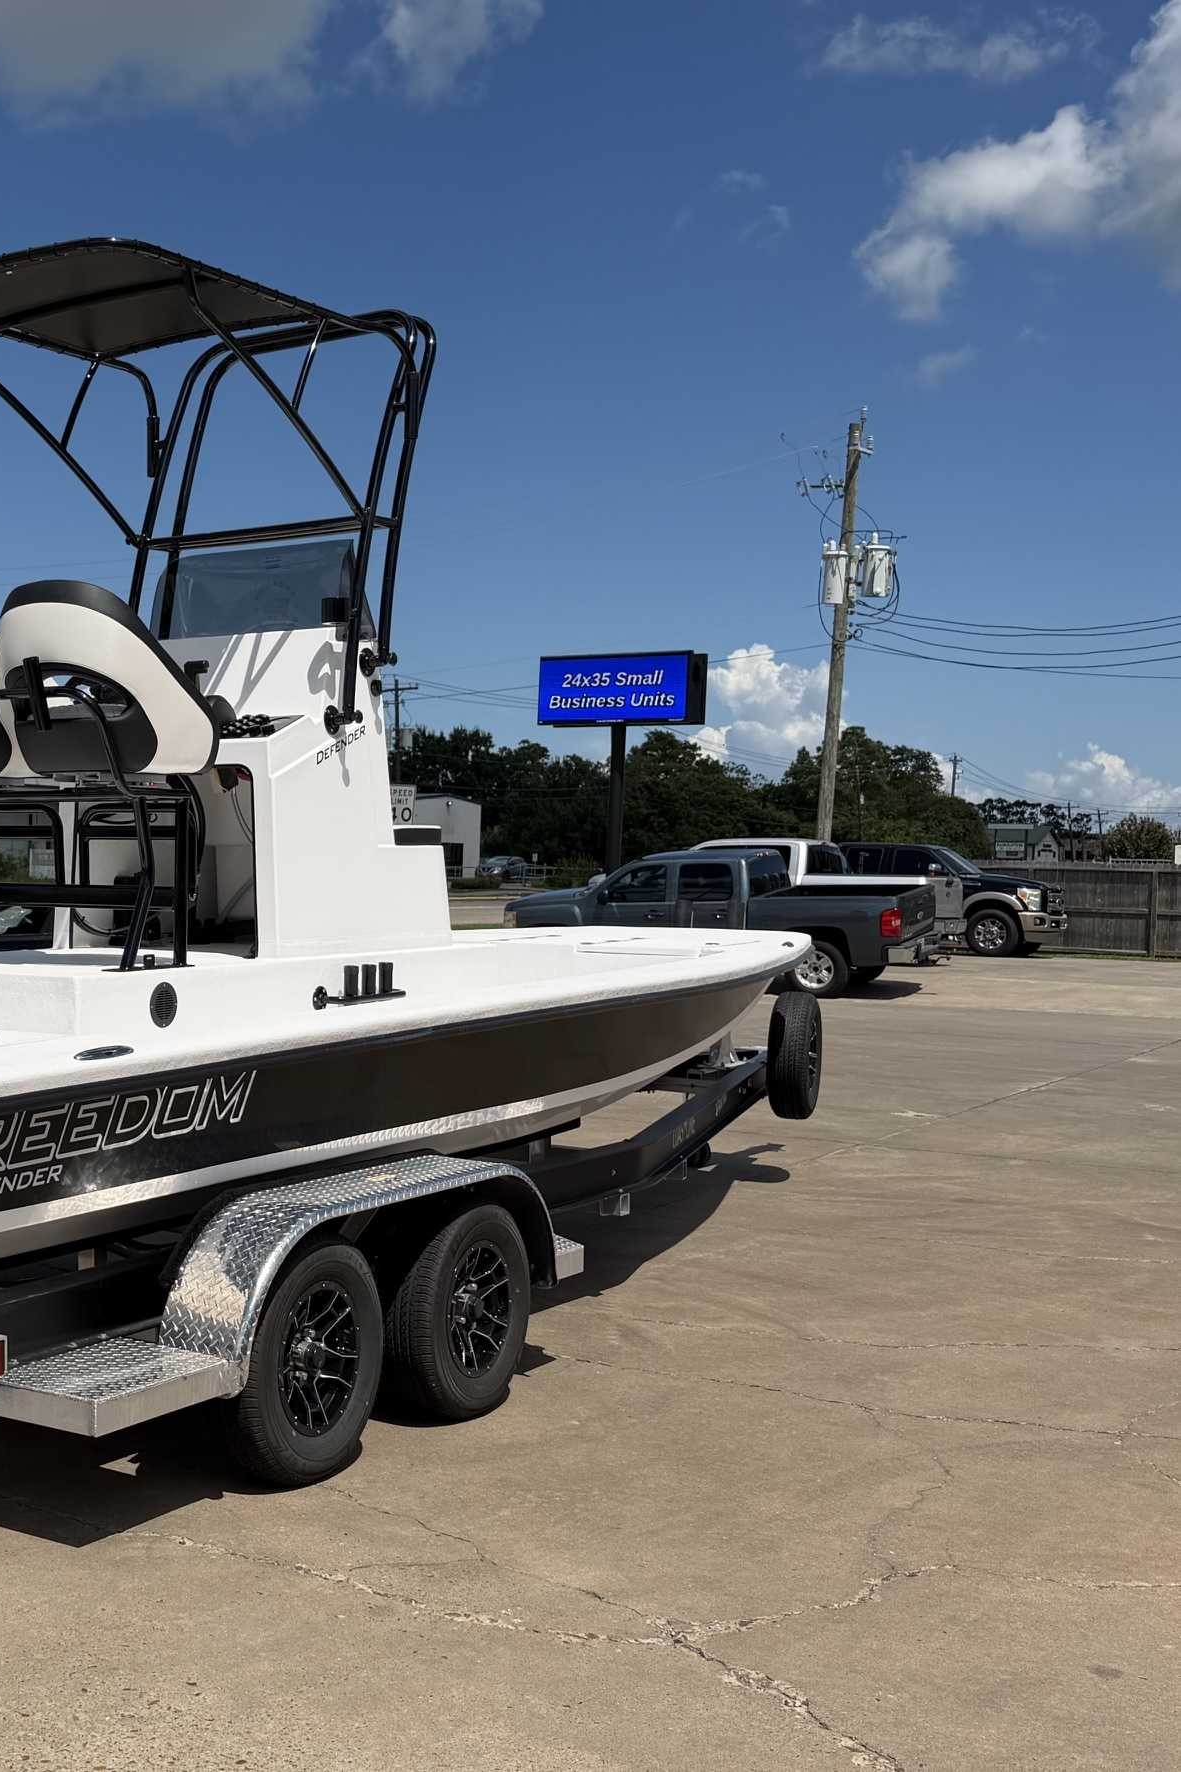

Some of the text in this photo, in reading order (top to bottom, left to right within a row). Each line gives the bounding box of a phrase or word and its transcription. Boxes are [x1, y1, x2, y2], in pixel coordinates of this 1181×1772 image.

[562, 669, 664, 688] 24x35 Small
[549, 691, 675, 709] Business Units
[317, 725, 366, 765] DEFENDER
